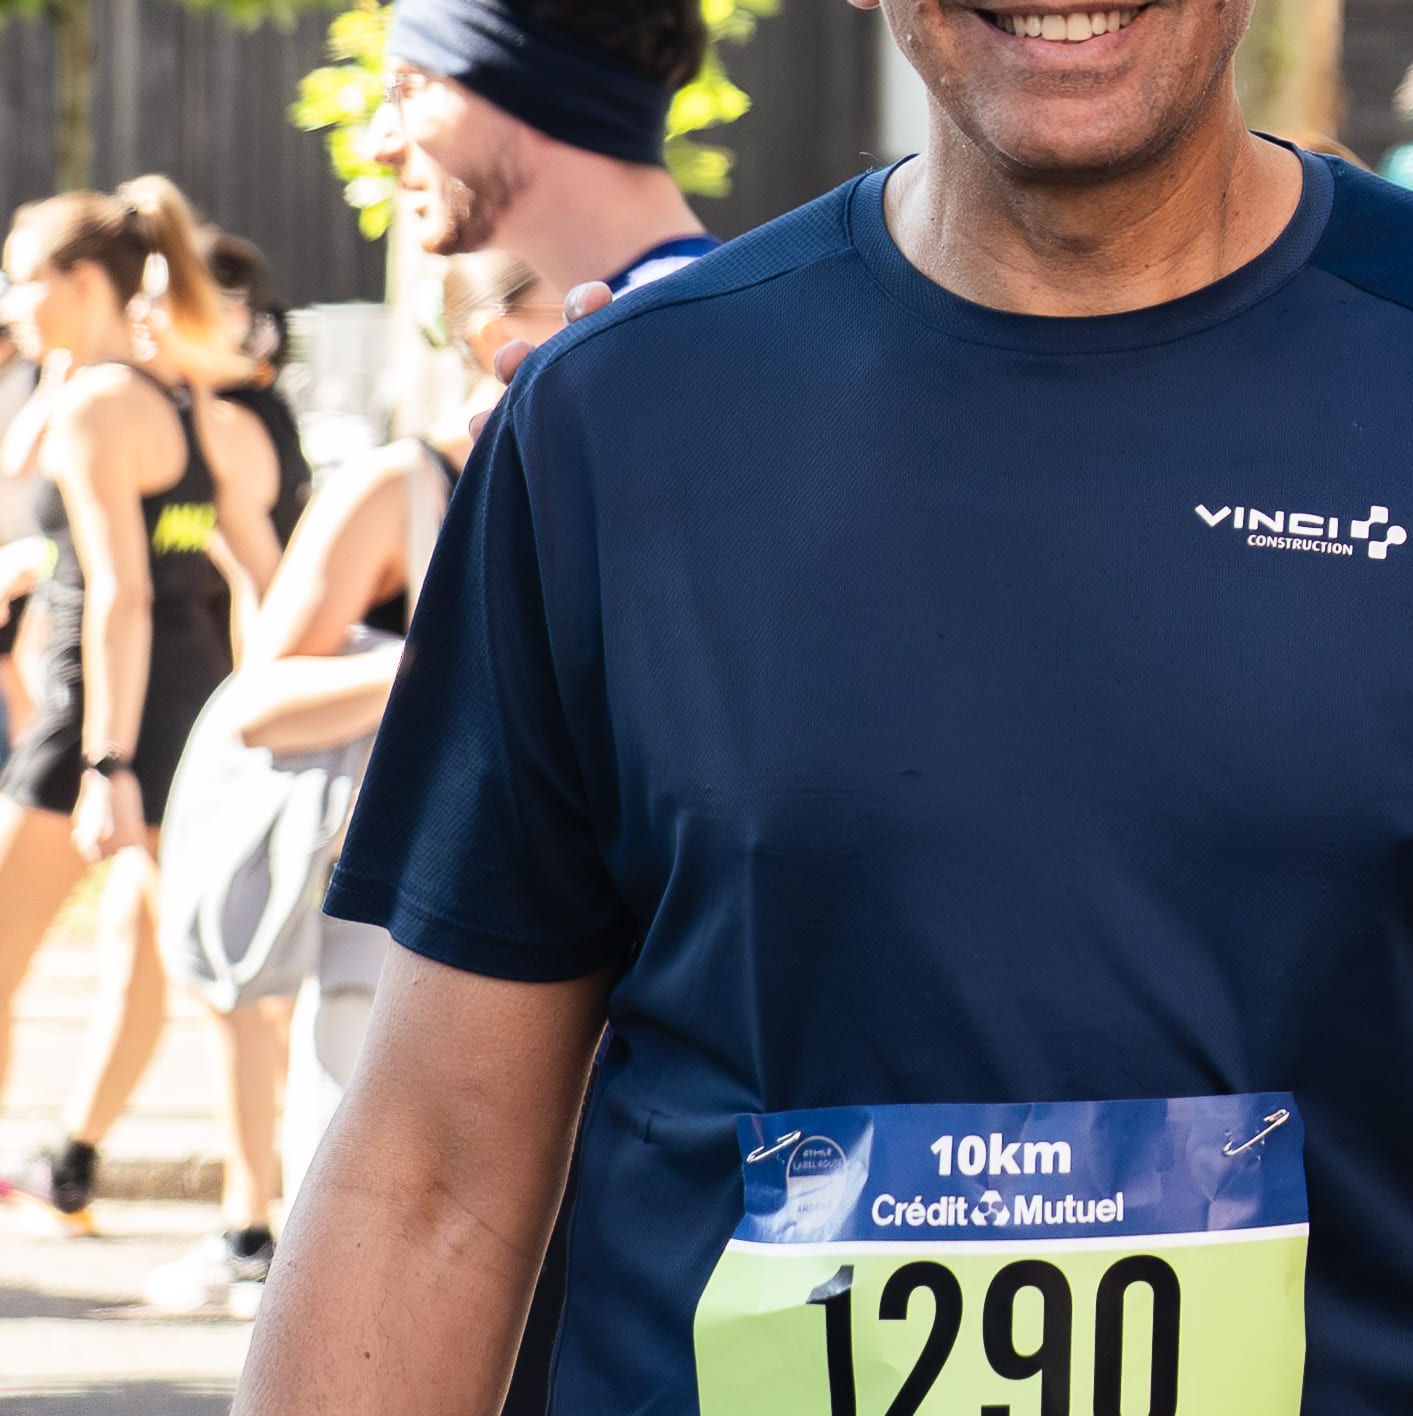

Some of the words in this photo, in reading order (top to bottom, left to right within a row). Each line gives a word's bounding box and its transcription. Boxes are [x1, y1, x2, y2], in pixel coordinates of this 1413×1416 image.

[1194, 504, 1339, 539] VINCI
[1247, 534, 1353, 556] CONSTRUCTION
[930, 1133, 1071, 1176] 10km
[871, 1194, 968, 1228] Crédit
[1014, 1192, 1125, 1225] Mutuel
[806, 1254, 1181, 1416] 1290
